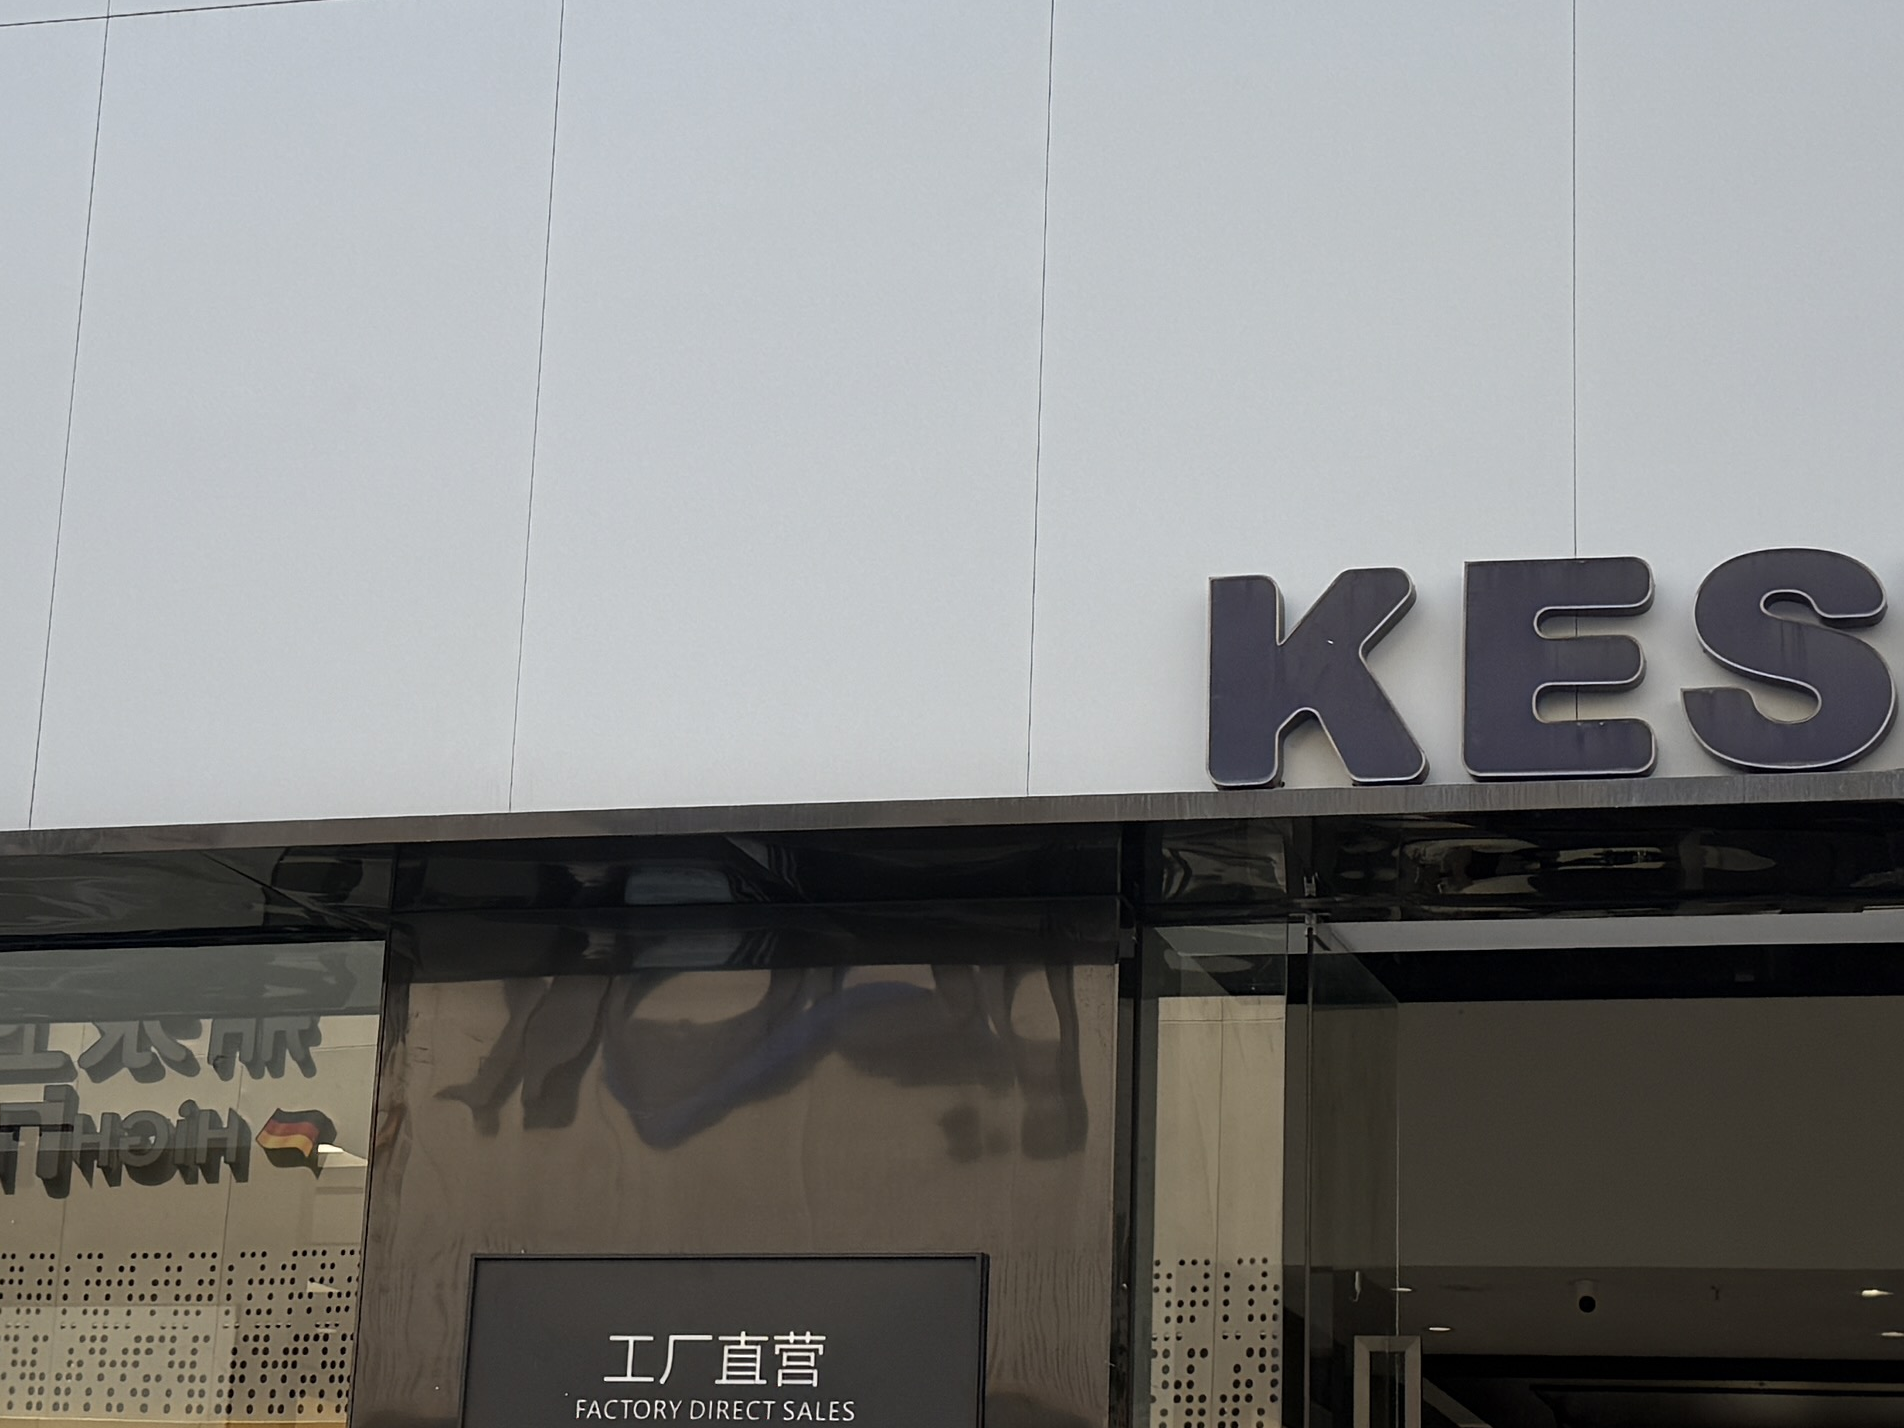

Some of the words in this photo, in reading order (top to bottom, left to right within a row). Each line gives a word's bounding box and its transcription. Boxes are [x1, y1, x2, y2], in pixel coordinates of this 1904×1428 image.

[604, 1330, 826, 1388] 工厂直营
[576, 1399, 682, 1420] FACTORY
[690, 1399, 776, 1421] DIRECT
[783, 1400, 855, 1422] SALES
